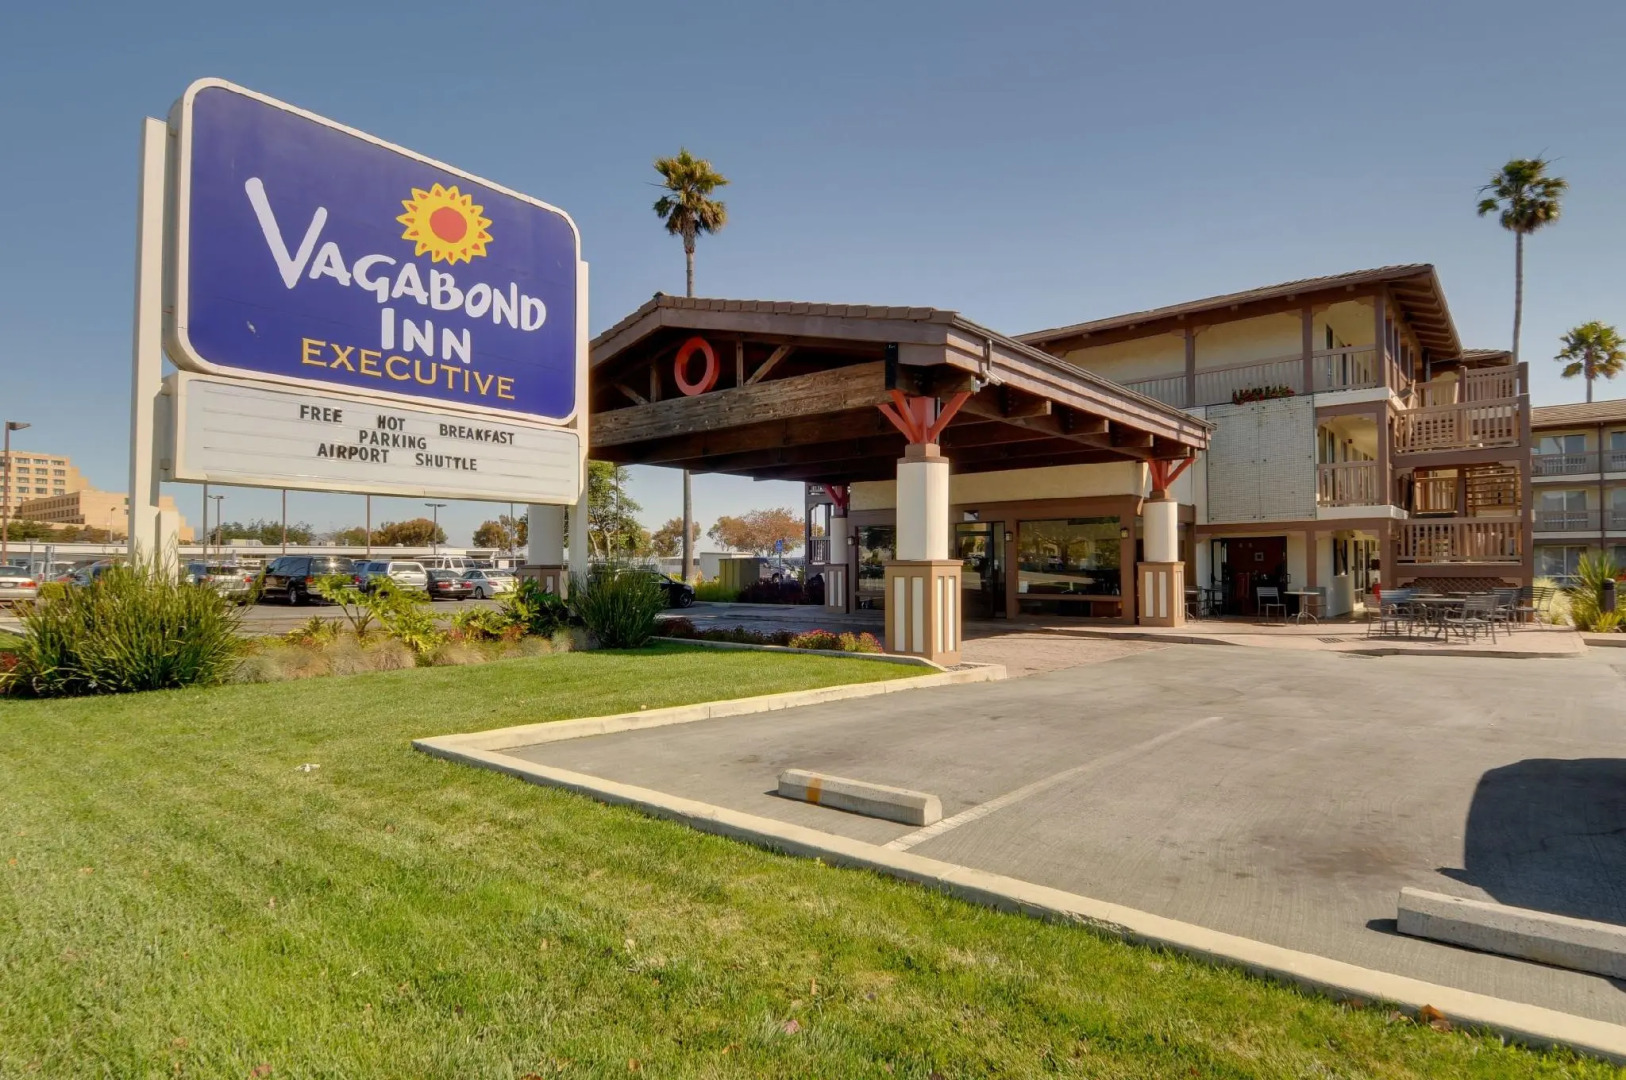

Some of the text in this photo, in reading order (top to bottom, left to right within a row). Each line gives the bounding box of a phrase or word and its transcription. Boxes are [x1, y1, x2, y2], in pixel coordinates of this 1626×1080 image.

[245, 177, 547, 331] VAGABOND
[381, 307, 471, 364] INN
[301, 337, 516, 400] EXECUTIVE
[300, 404, 515, 446] FREE HOT BREAKFAST
[359, 430, 427, 450] PARKING
[317, 443, 478, 471] AIRPORT SHUTTLE
